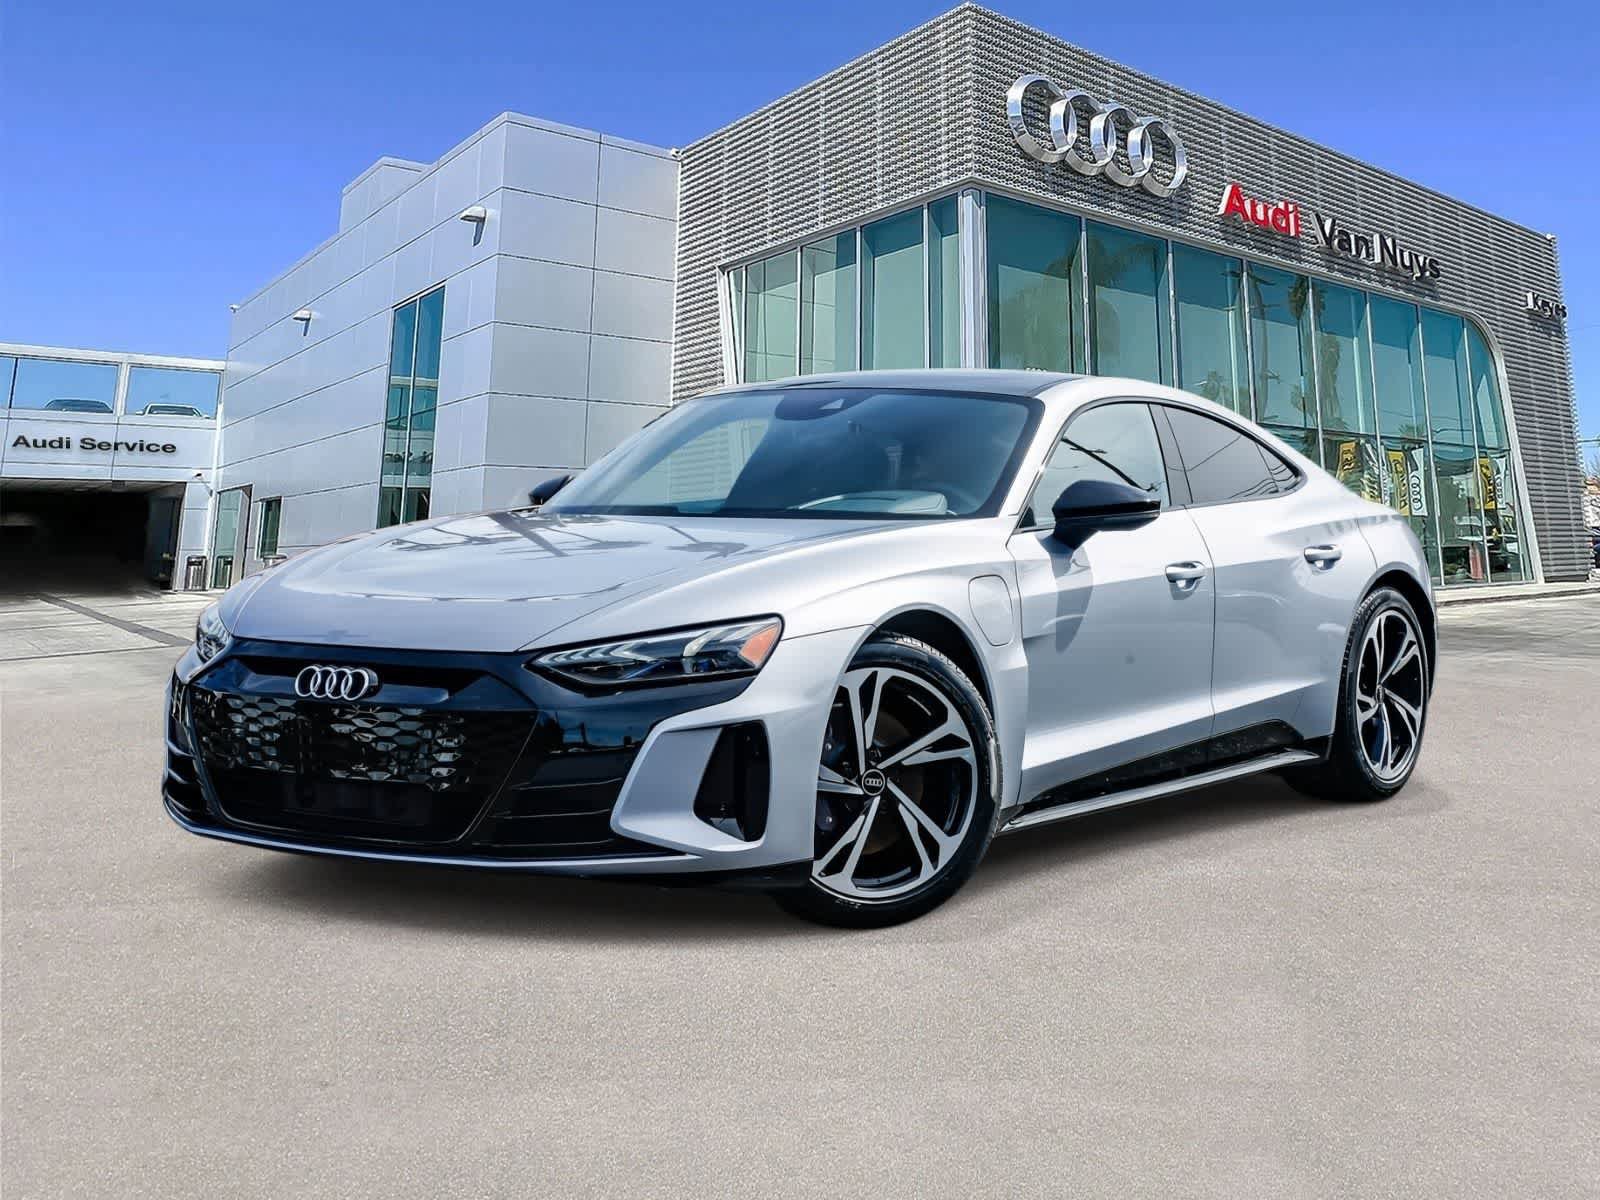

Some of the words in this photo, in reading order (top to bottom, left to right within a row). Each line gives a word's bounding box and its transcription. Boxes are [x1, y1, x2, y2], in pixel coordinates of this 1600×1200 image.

[1217, 182, 1300, 238] Audi
[1311, 213, 1371, 259] Van
[1374, 233, 1440, 281] Nuys
[12, 435, 71, 449] Audi
[80, 437, 177, 453] Service
